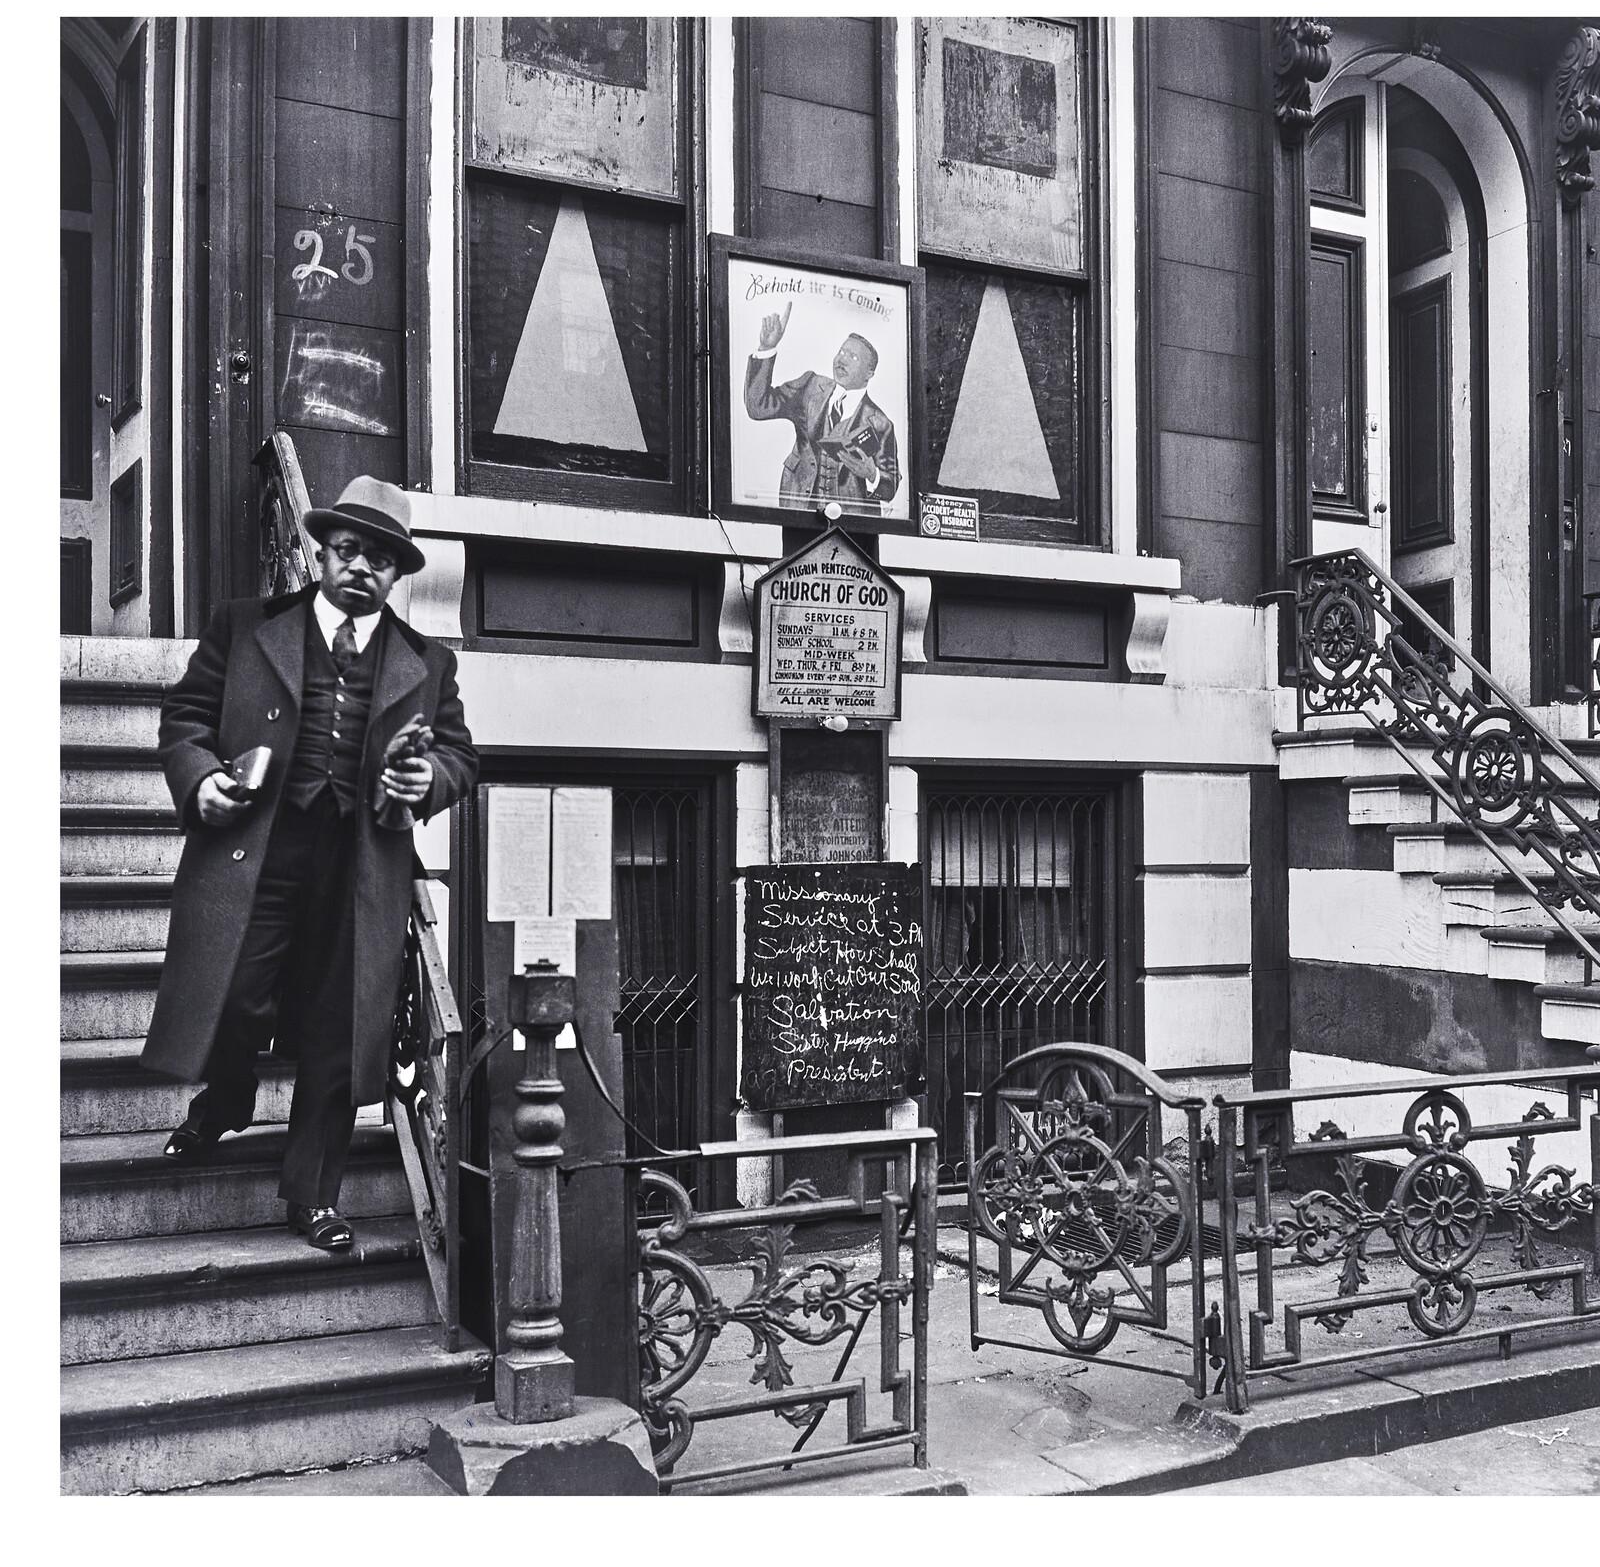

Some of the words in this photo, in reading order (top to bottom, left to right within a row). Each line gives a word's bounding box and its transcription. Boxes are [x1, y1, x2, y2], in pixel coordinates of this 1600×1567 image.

[292, 225, 377, 286] 25
[746, 274, 805, 301] Behold
[848, 288, 895, 323] Coming
[942, 515, 975, 528] INSURANCE
[788, 563, 818, 580] PILGRIM
[822, 563, 875, 584] PENTECOSTAL
[771, 580, 832, 603] CHURCH
[838, 584, 855, 604] OF
[859, 586, 889, 606] GOD
[805, 613, 856, 624] SERVICES
[777, 624, 814, 635] SUNDAYS
[777, 637, 804, 647] SUNDAY
[808, 638, 835, 649] SCHOOL
[858, 641, 865, 651] 2
[807, 673, 826, 681] EVERY
[780, 697, 805, 706] ALL
[807, 696, 831, 706] ARE
[835, 697, 876, 707] WELCOME
[826, 850, 869, 862] JOHNSON
[754, 880, 881, 914] Missionary
[763, 904, 855, 935] Service
[857, 918, 885, 937] at
[767, 994, 898, 1030] Salvation
[773, 1031, 830, 1056] Sister
